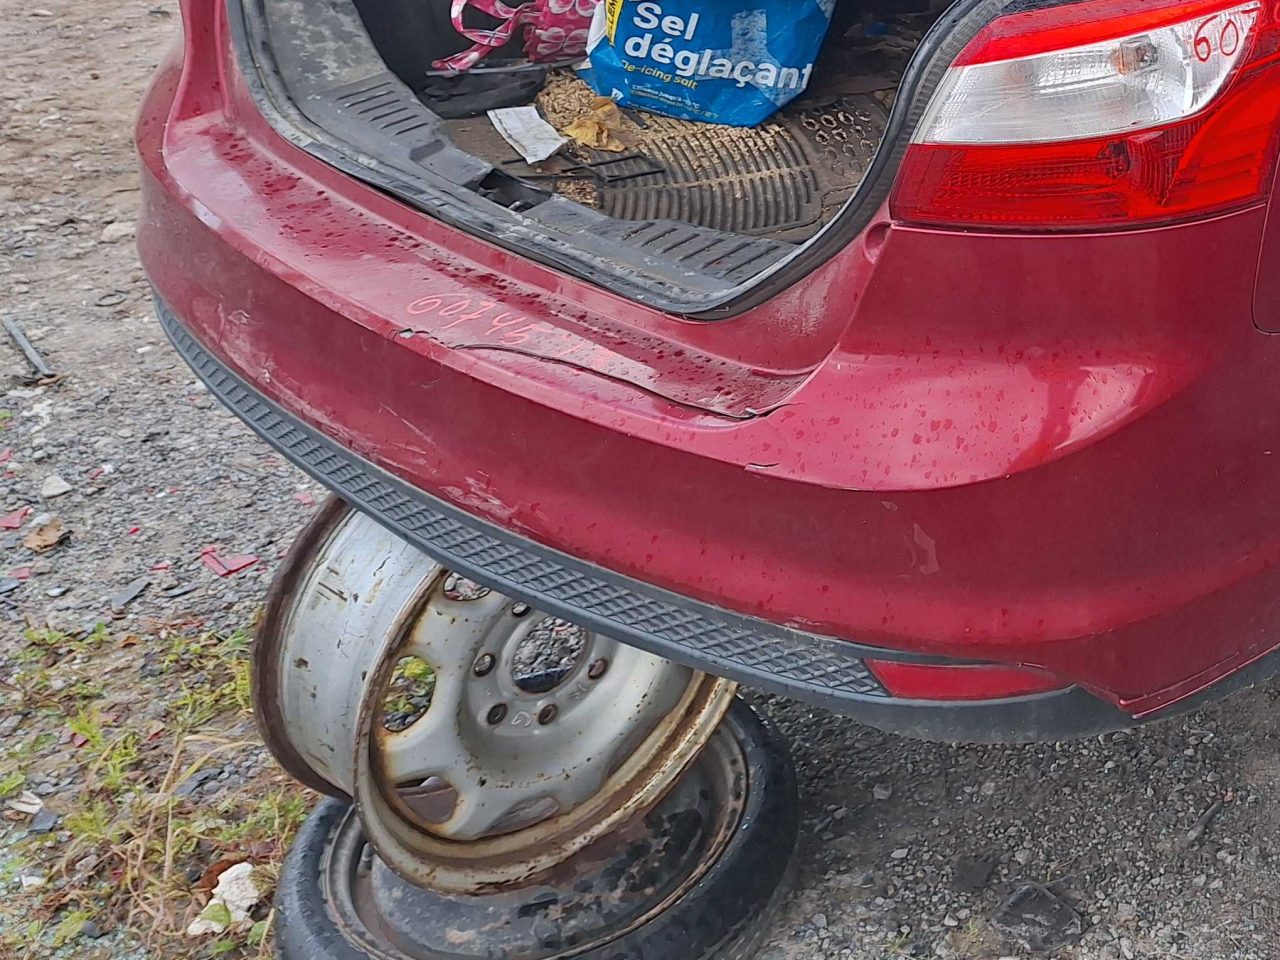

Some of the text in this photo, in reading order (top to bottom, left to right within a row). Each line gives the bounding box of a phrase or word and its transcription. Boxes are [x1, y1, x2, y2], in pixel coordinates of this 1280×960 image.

[632, 2, 700, 40] Sel
[624, 33, 813, 88] déglaçant
[673, 76, 698, 90] salt
